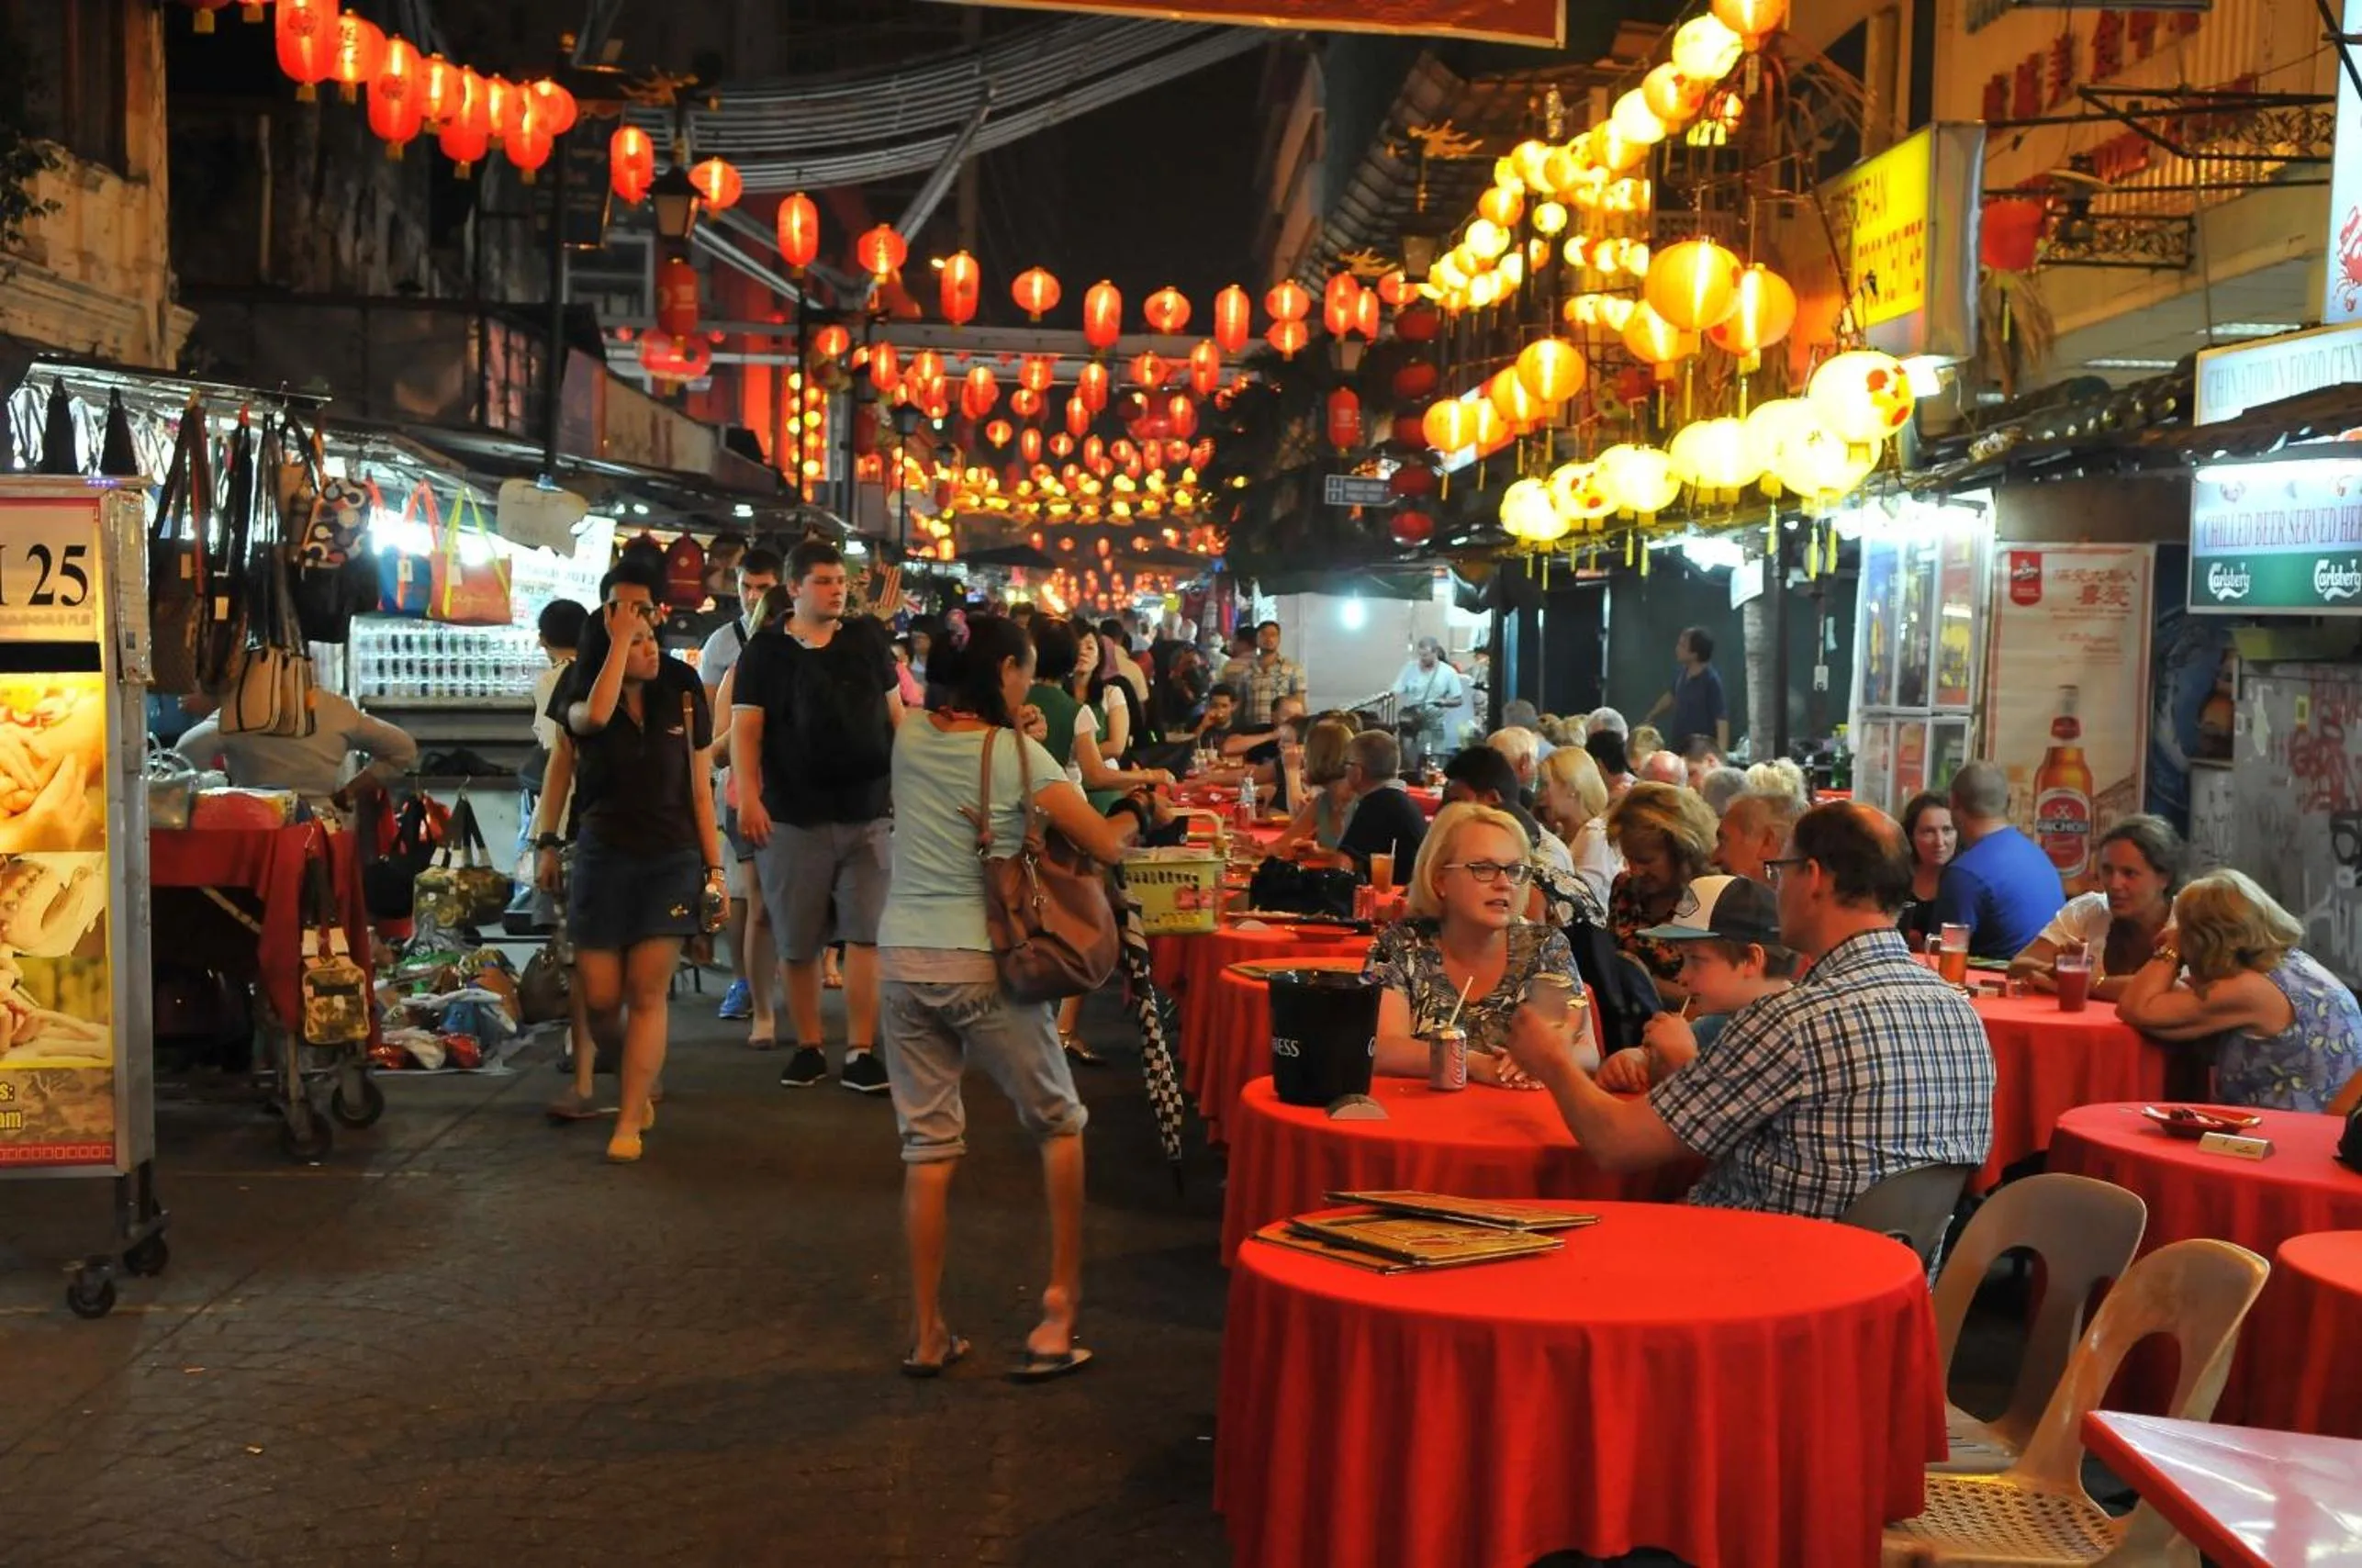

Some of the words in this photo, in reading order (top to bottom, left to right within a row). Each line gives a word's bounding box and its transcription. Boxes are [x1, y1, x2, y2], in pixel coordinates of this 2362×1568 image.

[2289, 350, 2327, 395] FOOD
[2203, 513, 2253, 549] CHILLED
[2255, 510, 2286, 545] BEER
[2289, 507, 2336, 544] SERVED
[26, 543, 89, 607] 25
[2207, 561, 2251, 599] Carlsberg
[2313, 558, 2362, 599] Carlsberg
